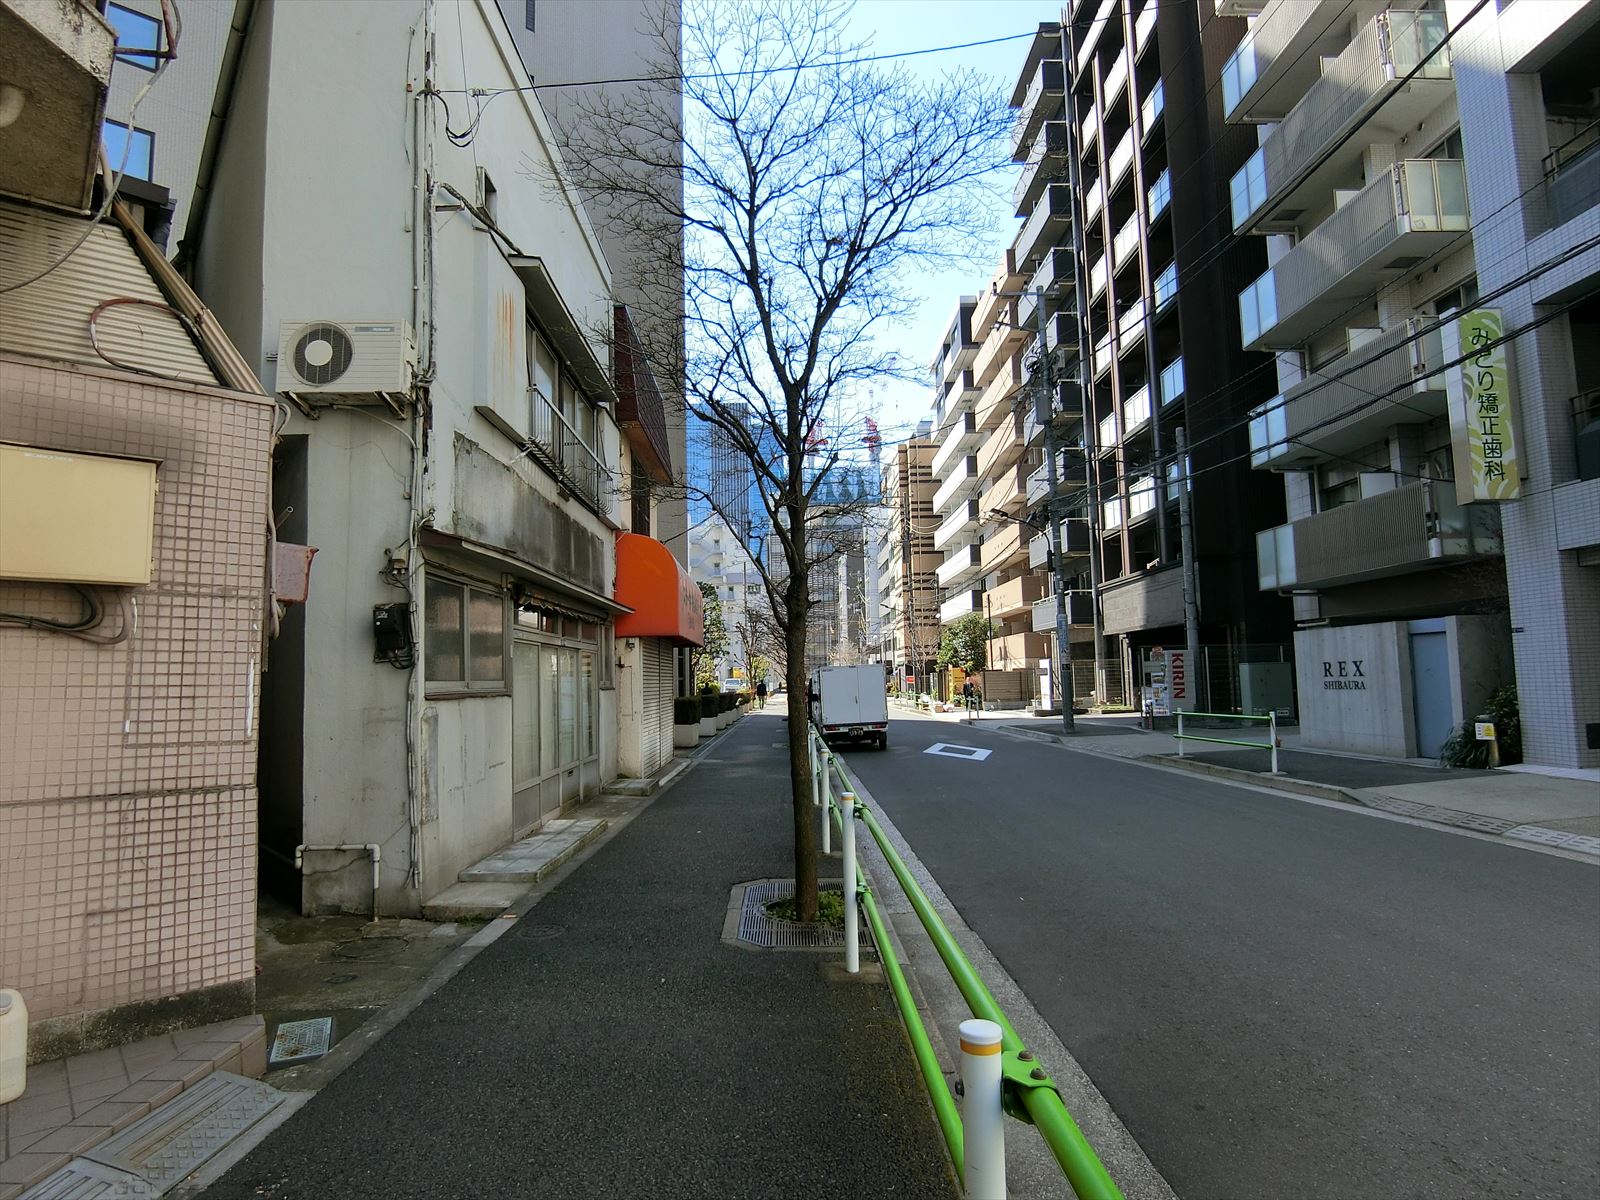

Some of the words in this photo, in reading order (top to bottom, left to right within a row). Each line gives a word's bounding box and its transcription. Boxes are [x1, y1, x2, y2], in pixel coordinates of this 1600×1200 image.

[1171, 653, 1186, 699] KIRIN
[1322, 660, 1365, 677] REX
[1323, 680, 1367, 690] SHIBAURA
